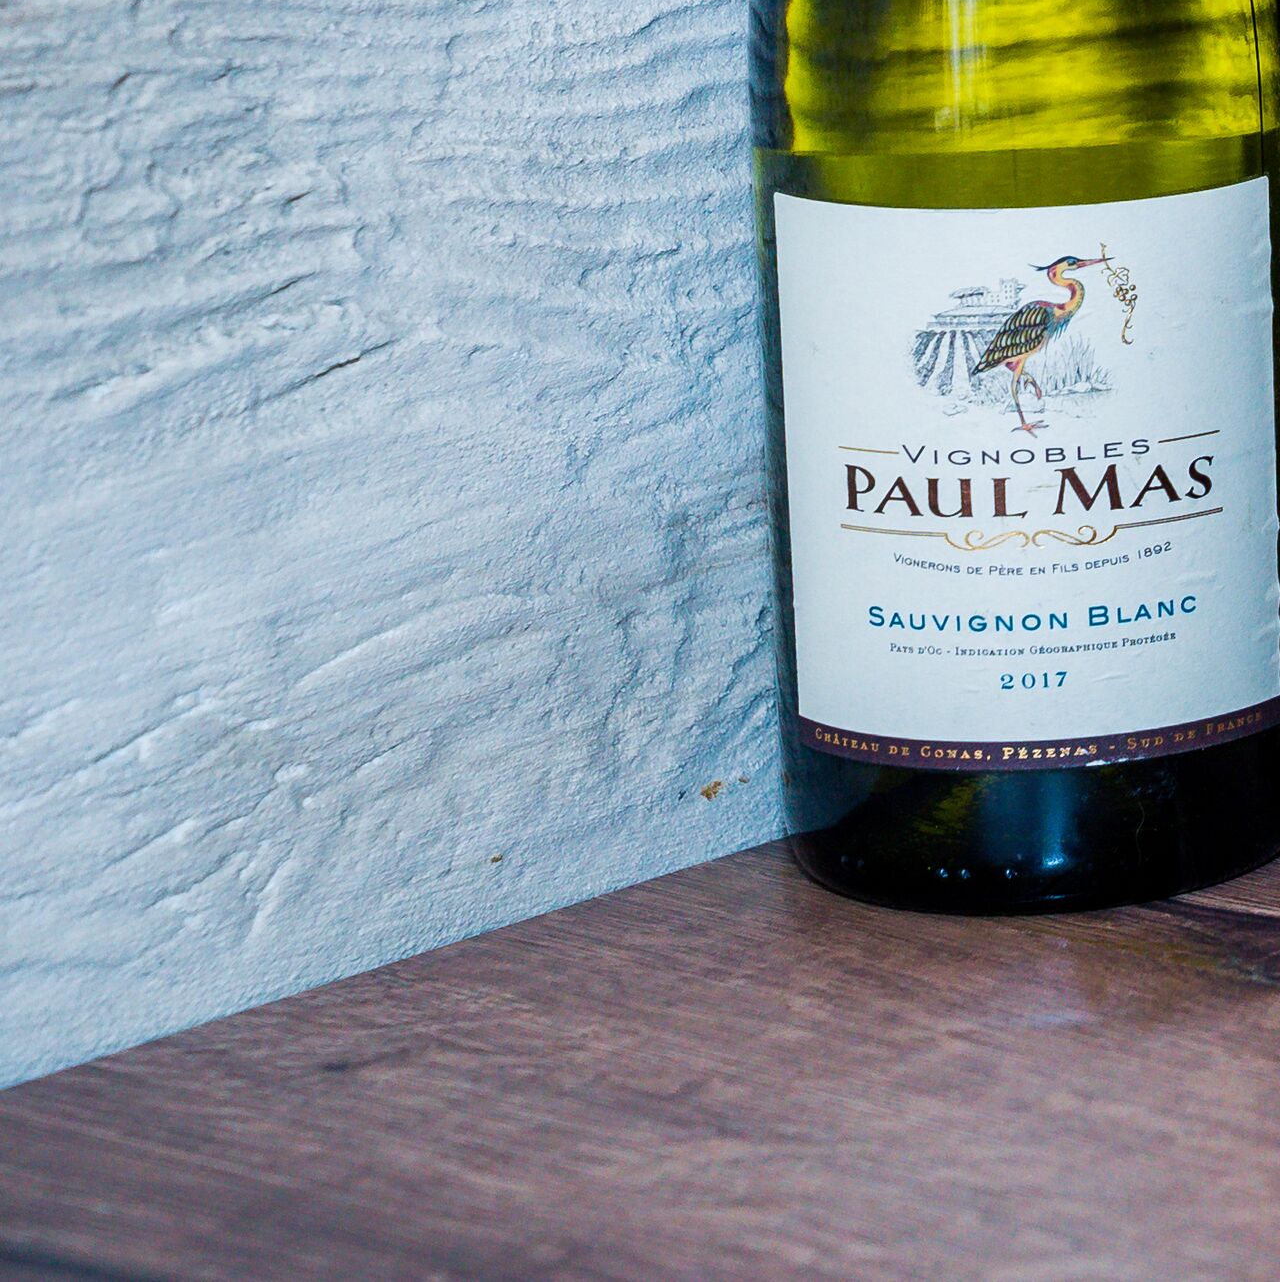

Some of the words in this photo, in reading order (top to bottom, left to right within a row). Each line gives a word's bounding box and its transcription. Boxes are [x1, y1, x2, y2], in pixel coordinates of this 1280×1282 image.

[902, 439, 1151, 466] VIGNOBLES
[844, 463, 1029, 519] PAUL
[1053, 455, 1215, 516] MAS
[1137, 541, 1172, 560] 1892
[868, 605, 1069, 633] SAUVIGNON
[1088, 594, 1199, 628] BLANC
[1000, 670, 1068, 690] 2017
